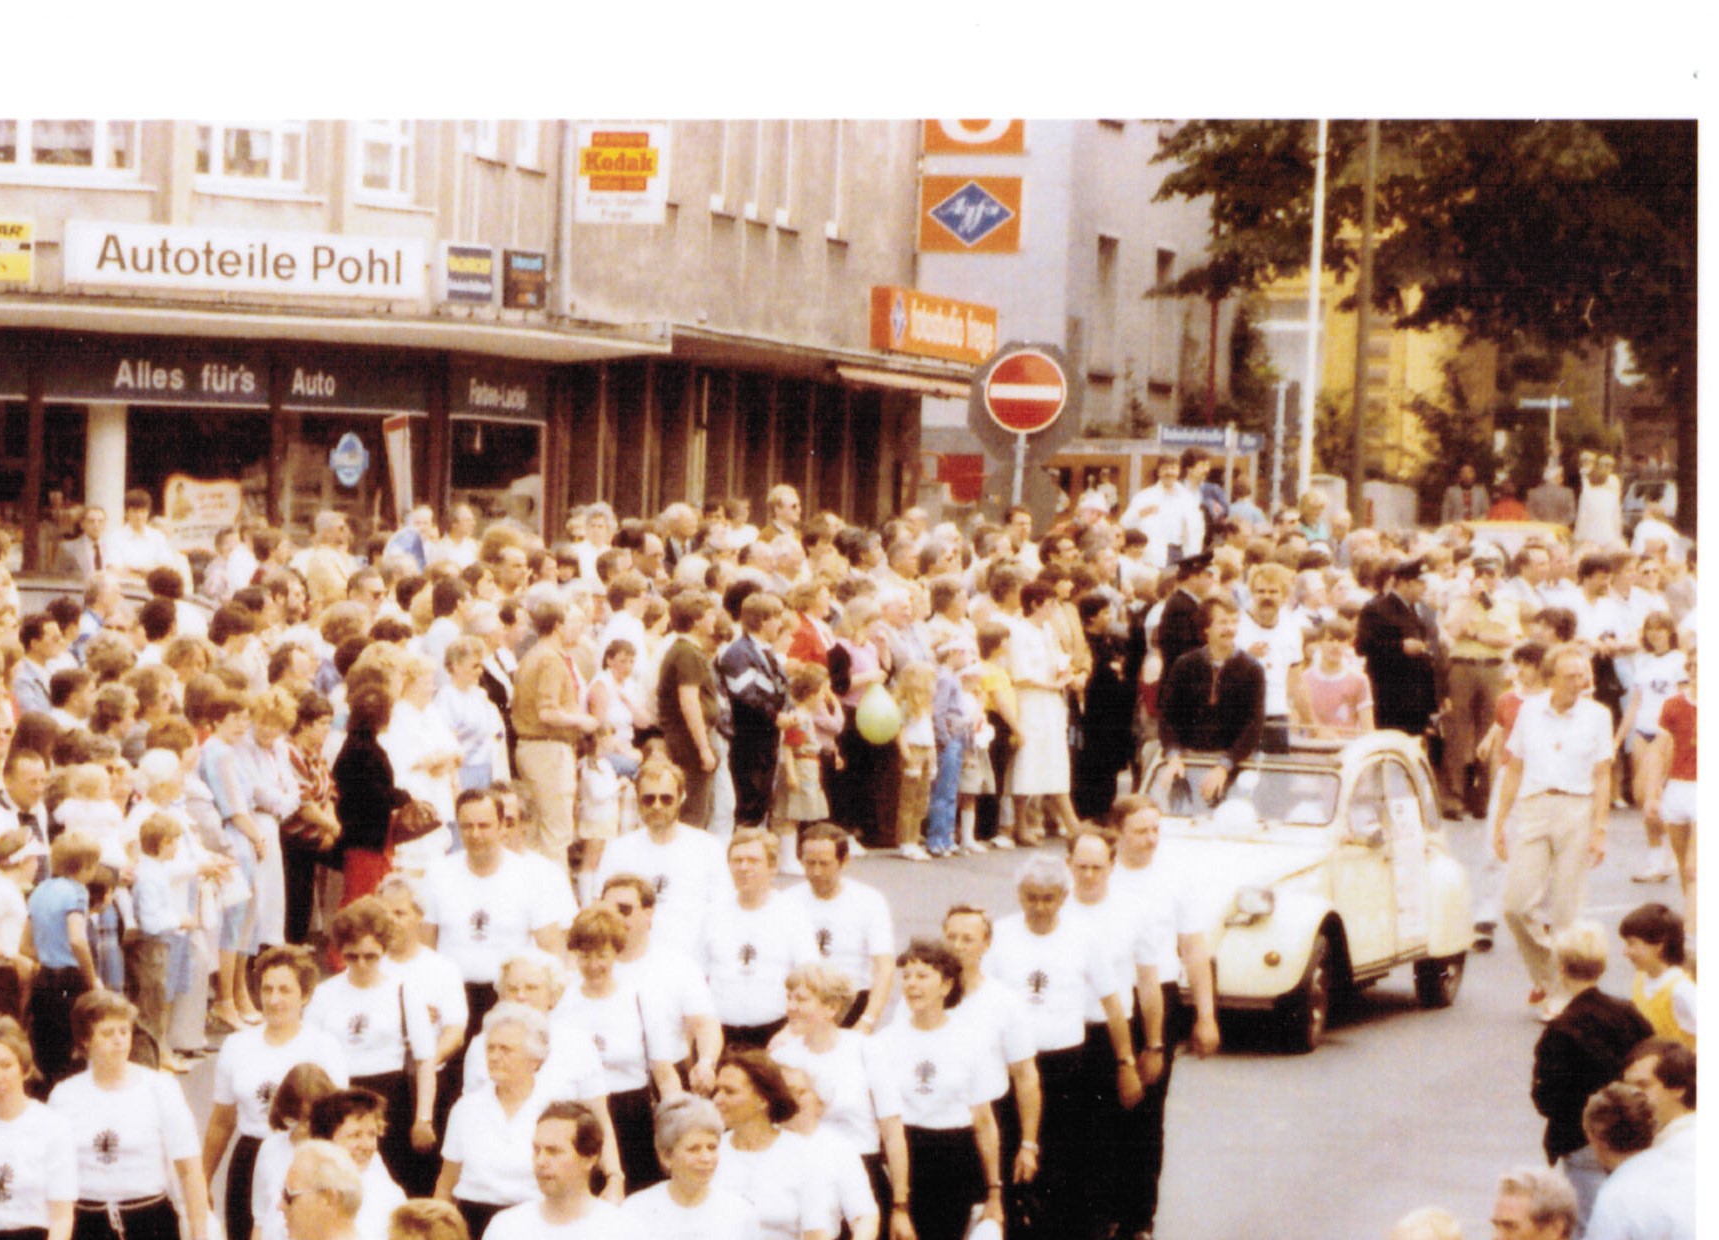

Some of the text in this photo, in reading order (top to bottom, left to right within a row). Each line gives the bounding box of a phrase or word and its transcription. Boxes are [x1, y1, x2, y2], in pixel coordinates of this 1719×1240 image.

[585, 151, 653, 172] Kodak
[95, 233, 297, 282] Autoteile
[312, 245, 403, 285] Pohl
[114, 360, 185, 390] Alles
[291, 368, 337, 397] Auto
